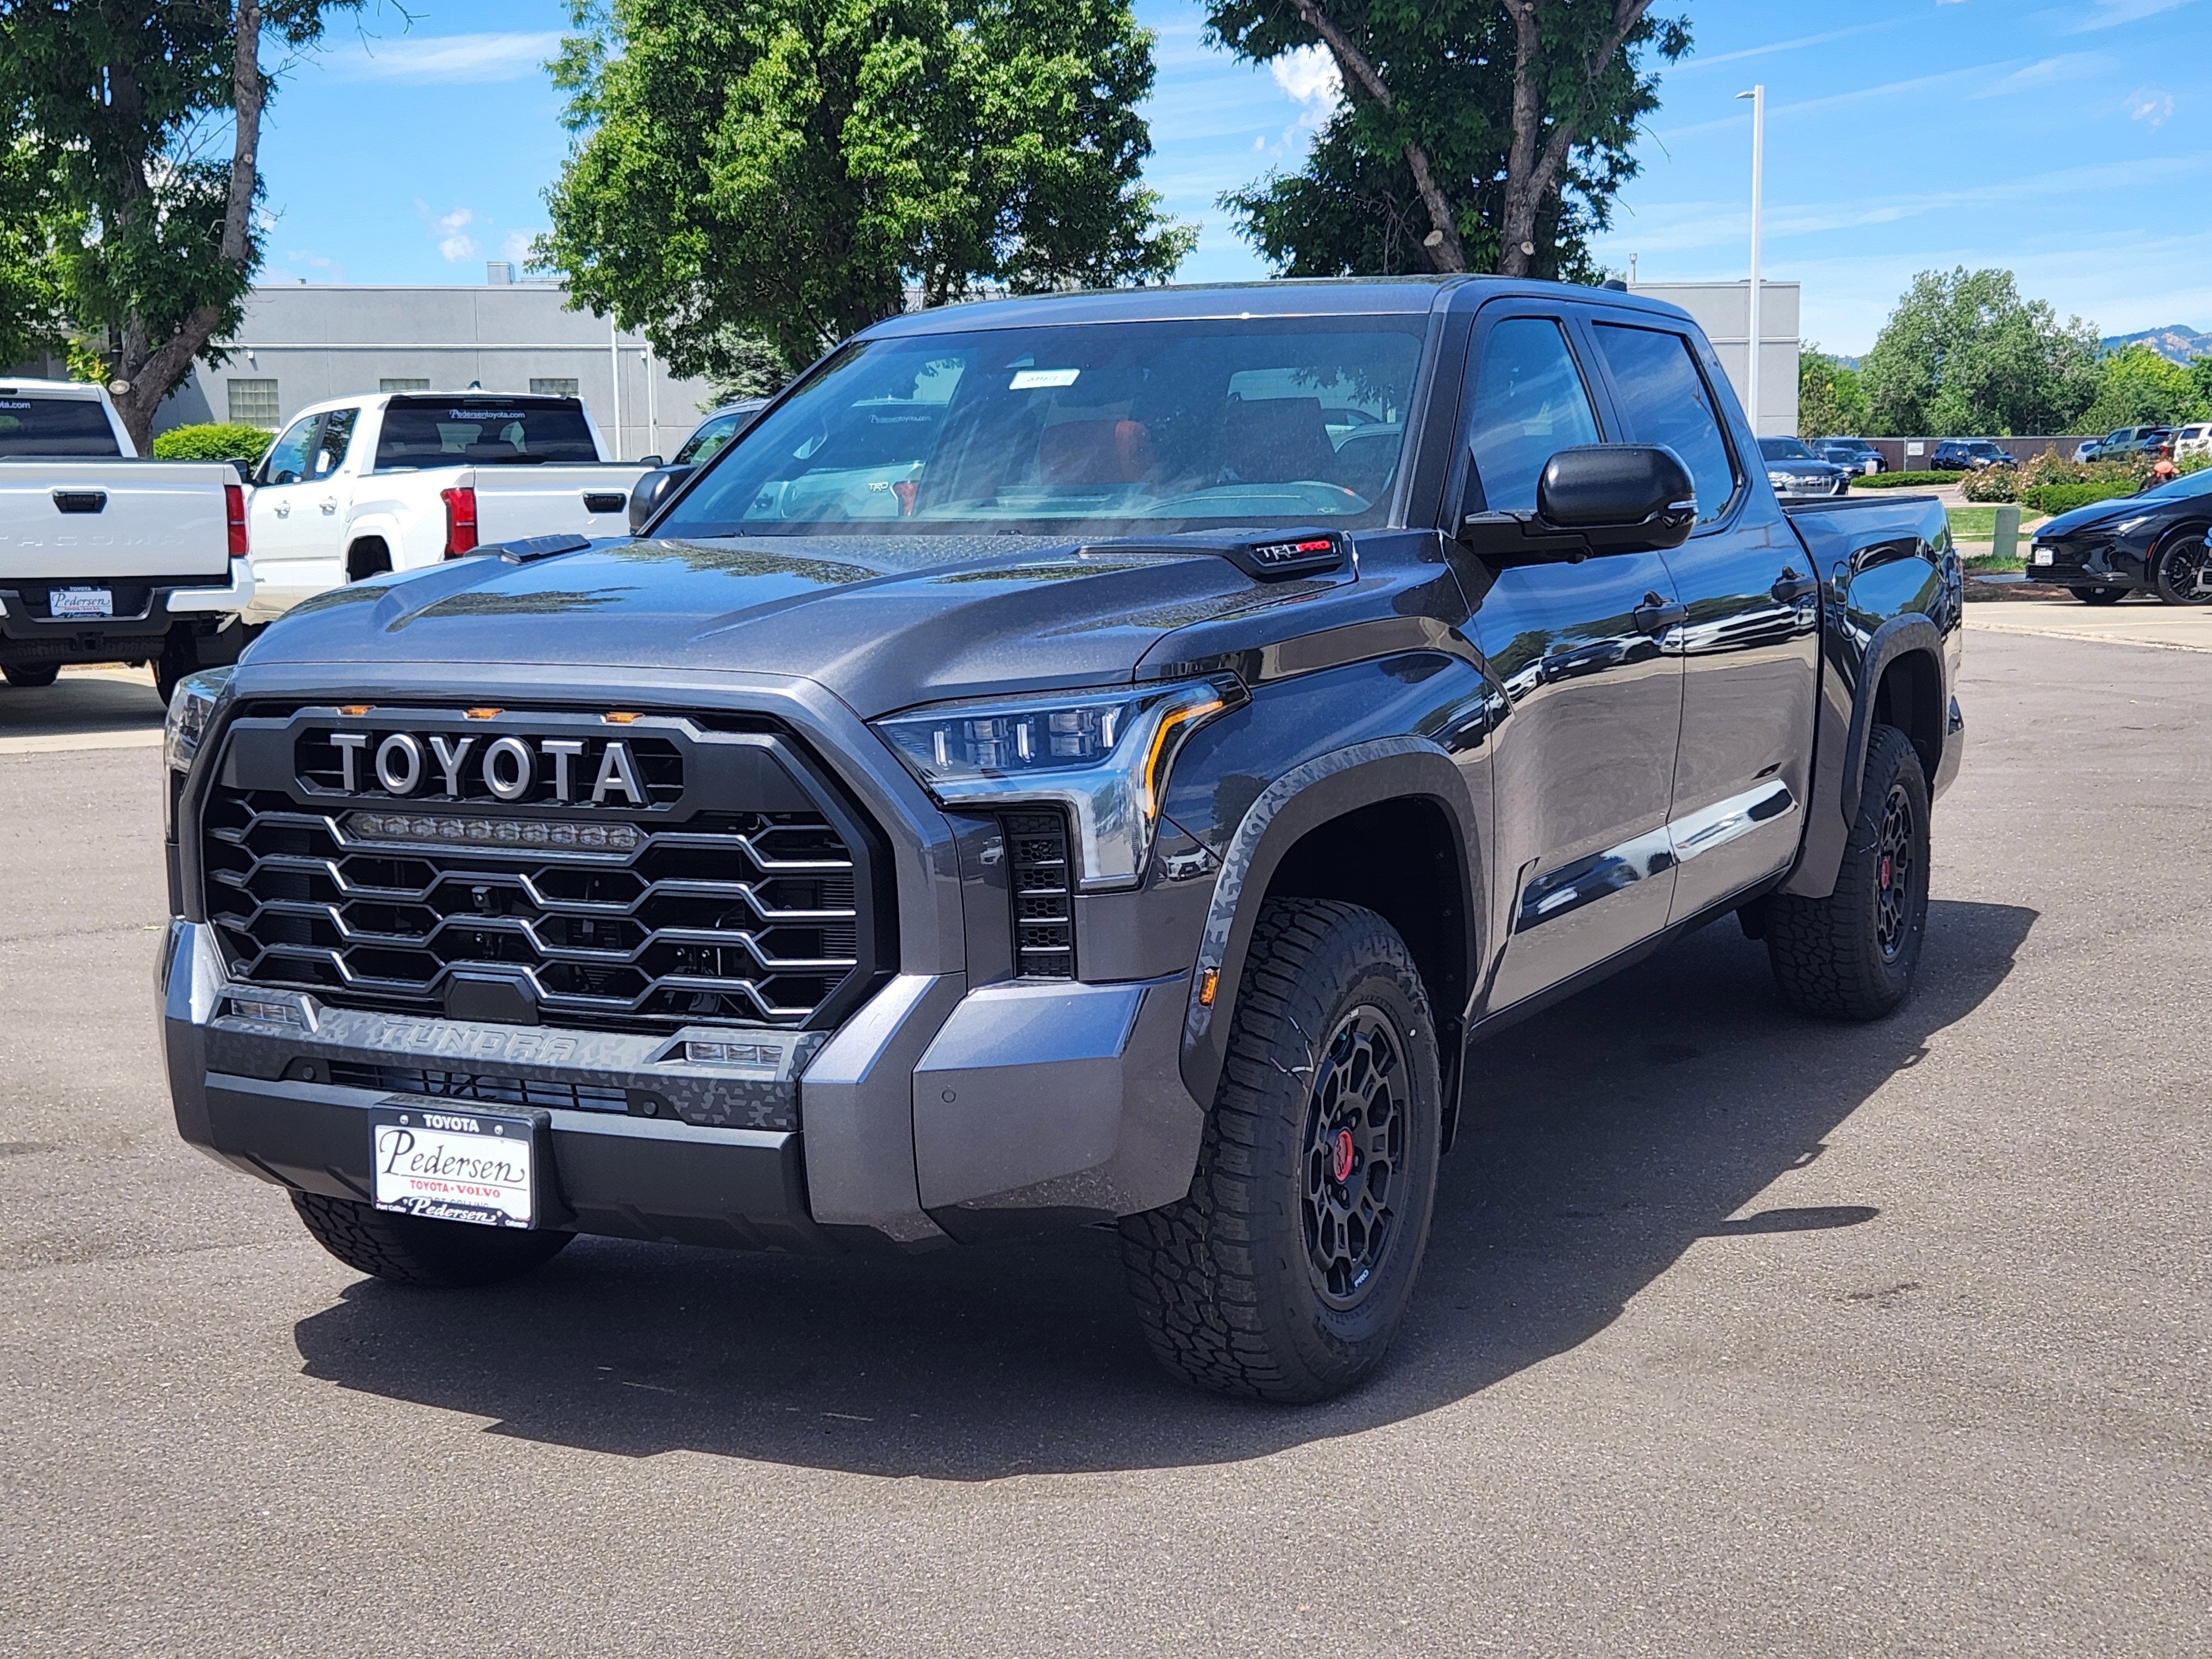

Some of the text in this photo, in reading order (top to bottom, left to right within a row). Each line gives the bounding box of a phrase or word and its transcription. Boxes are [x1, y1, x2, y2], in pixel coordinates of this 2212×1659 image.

[1256, 540, 1331, 560] TRD PRO
[52, 593, 111, 607] Pedersen
[330, 733, 643, 803] TOYOTA
[383, 1021, 578, 1061] TUNDRA
[422, 1114, 479, 1133] TOYOTA
[379, 1130, 525, 1183] Pedersen
[410, 1180, 500, 1198] TOYOTA VOLVO
[408, 1196, 497, 1222] Pedersen
[1354, 1269, 1369, 1287] PRO
